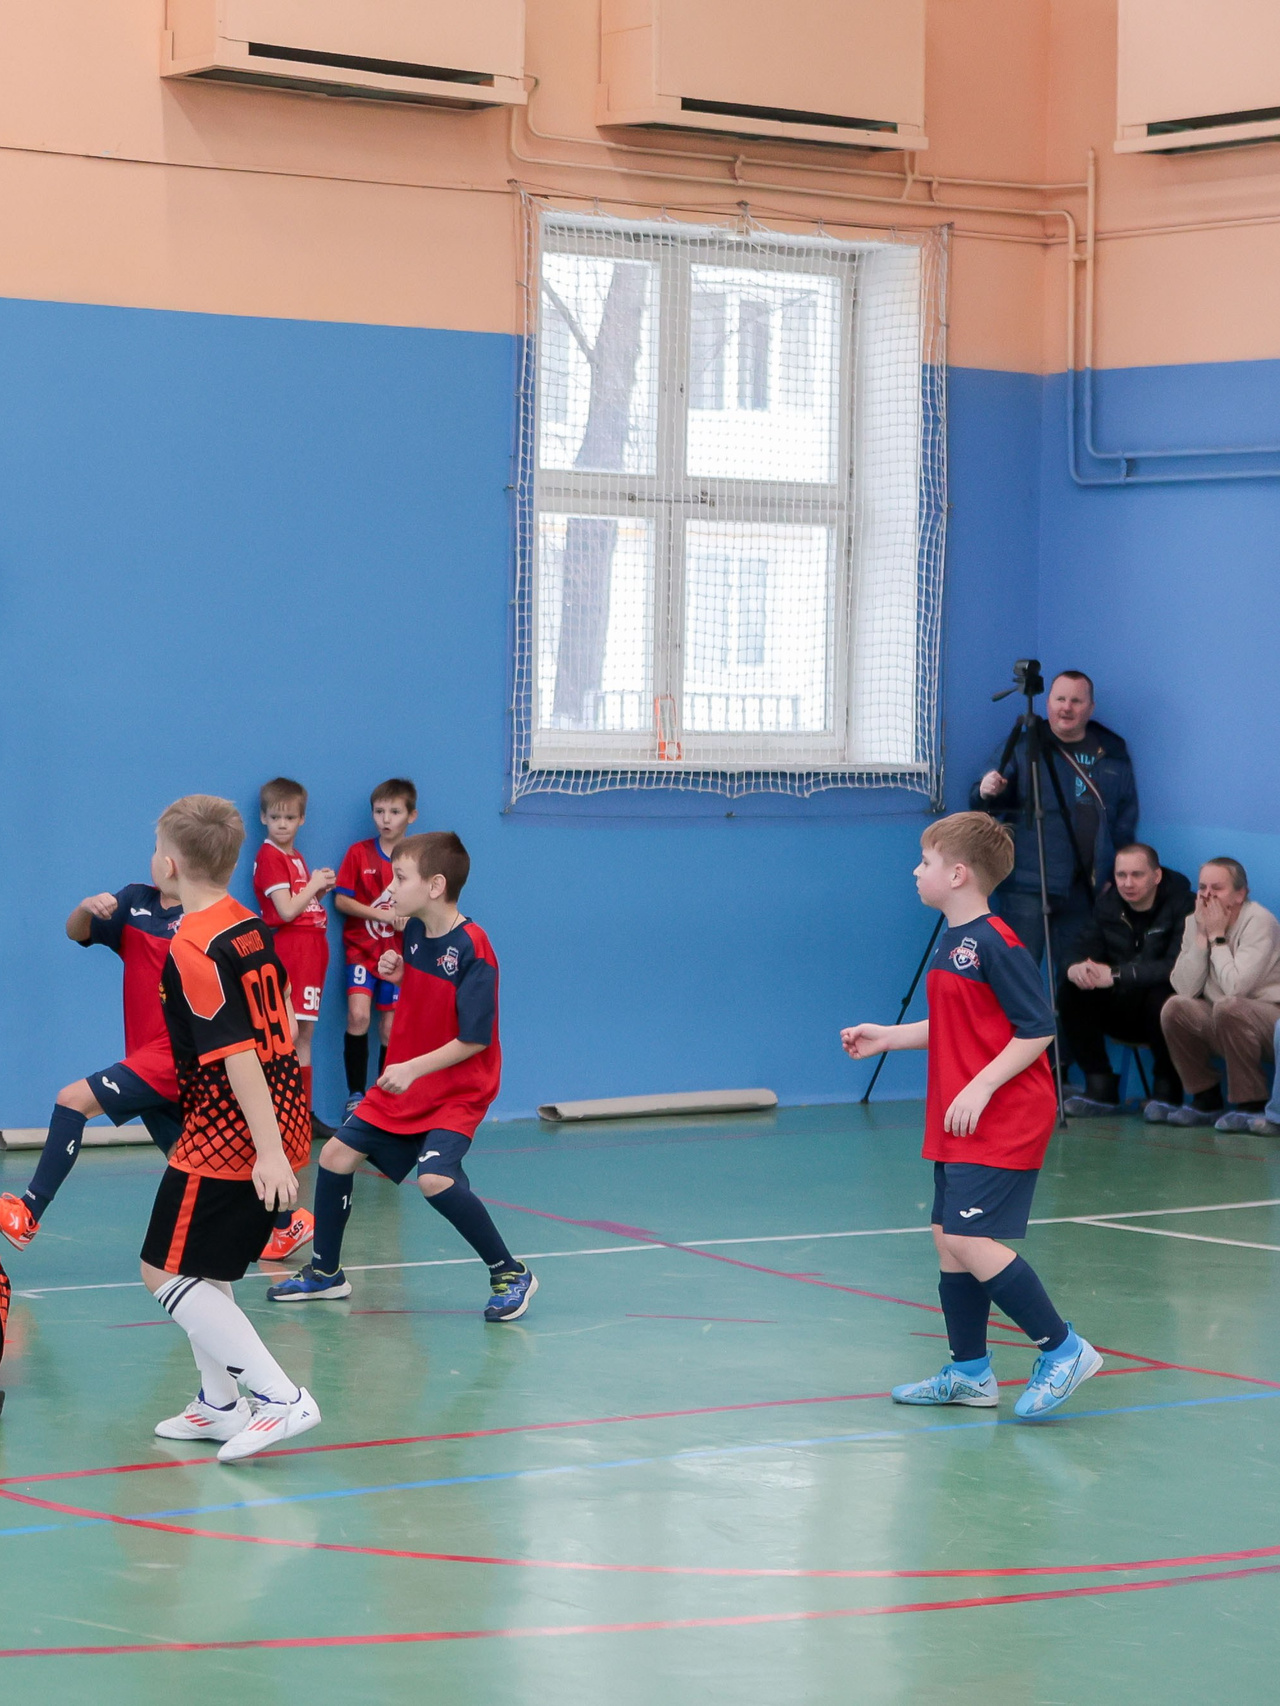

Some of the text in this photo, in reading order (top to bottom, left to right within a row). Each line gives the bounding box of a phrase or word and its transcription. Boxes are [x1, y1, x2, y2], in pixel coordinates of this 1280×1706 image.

[353, 964, 367, 986] 9
[241, 963, 296, 1063] 99
[66, 1139, 76, 1156] 4
